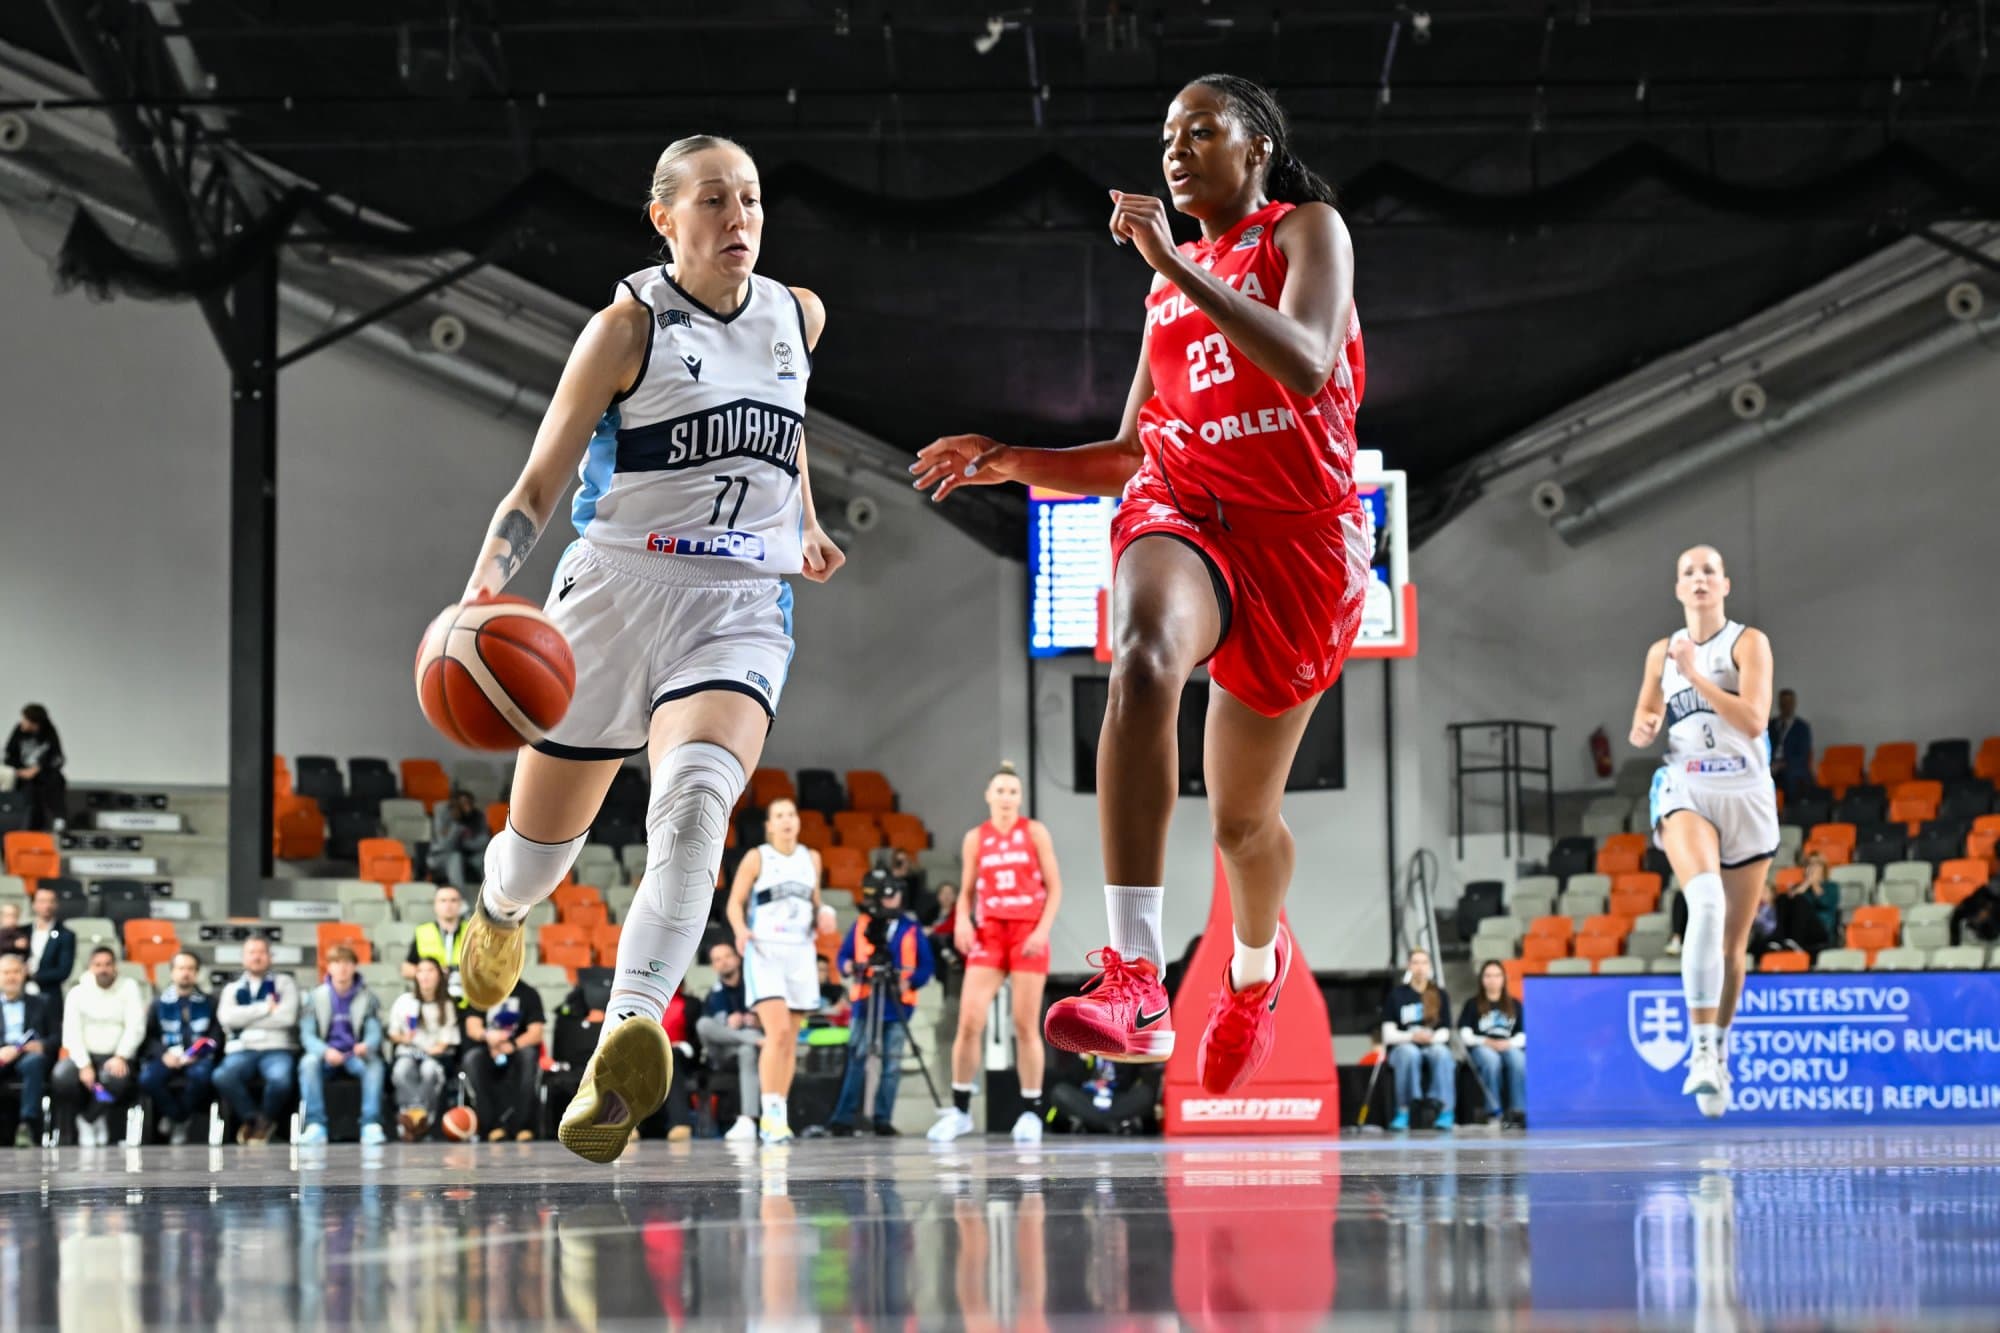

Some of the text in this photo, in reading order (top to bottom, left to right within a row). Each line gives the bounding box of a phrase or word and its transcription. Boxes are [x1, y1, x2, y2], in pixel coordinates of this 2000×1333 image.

[1147, 272, 1266, 336] POLA
[1186, 332, 1235, 392] 23
[667, 407, 802, 466] SLOVAKIA
[1200, 407, 1297, 444] ORLEN
[708, 475, 749, 529] 77
[1702, 724, 1716, 749] 3
[1730, 1024, 2000, 1054] ESTOVNÉHO RUCHU
[1737, 1054, 1848, 1083] ŠPORTU
[1728, 1086, 1874, 1115] LOVENSKEJ
